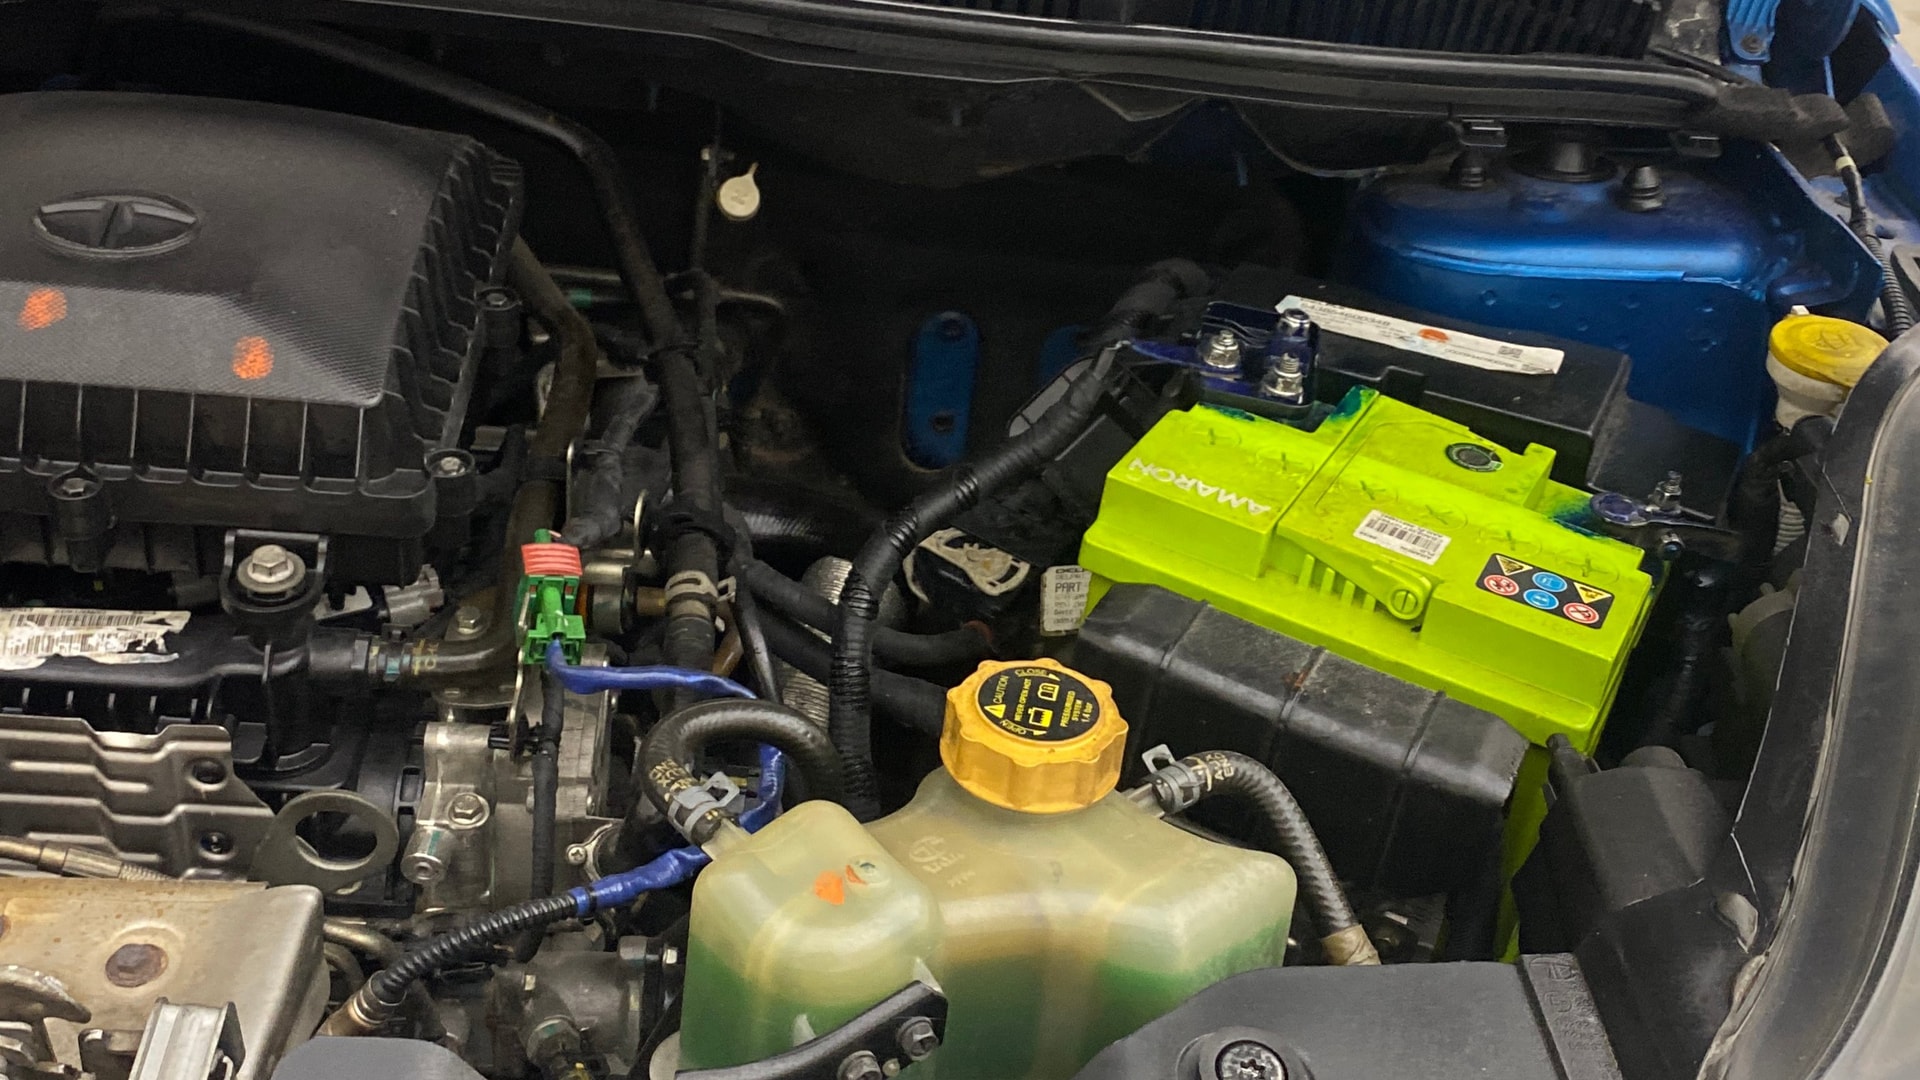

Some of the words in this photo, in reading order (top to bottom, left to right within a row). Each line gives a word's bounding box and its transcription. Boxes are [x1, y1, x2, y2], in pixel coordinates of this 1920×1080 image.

[1128, 457, 1271, 515] AMARON
[1055, 582, 1082, 593] PART
[1014, 668, 1048, 677] CLOSE
[993, 674, 1009, 704] CAUTION
[1023, 678, 1032, 690] HOT
[1018, 688, 1030, 704] OPEN
[1014, 703, 1025, 722] NEVER
[1071, 699, 1083, 722] SYSTEM
[999, 719, 1027, 735] OPEN
